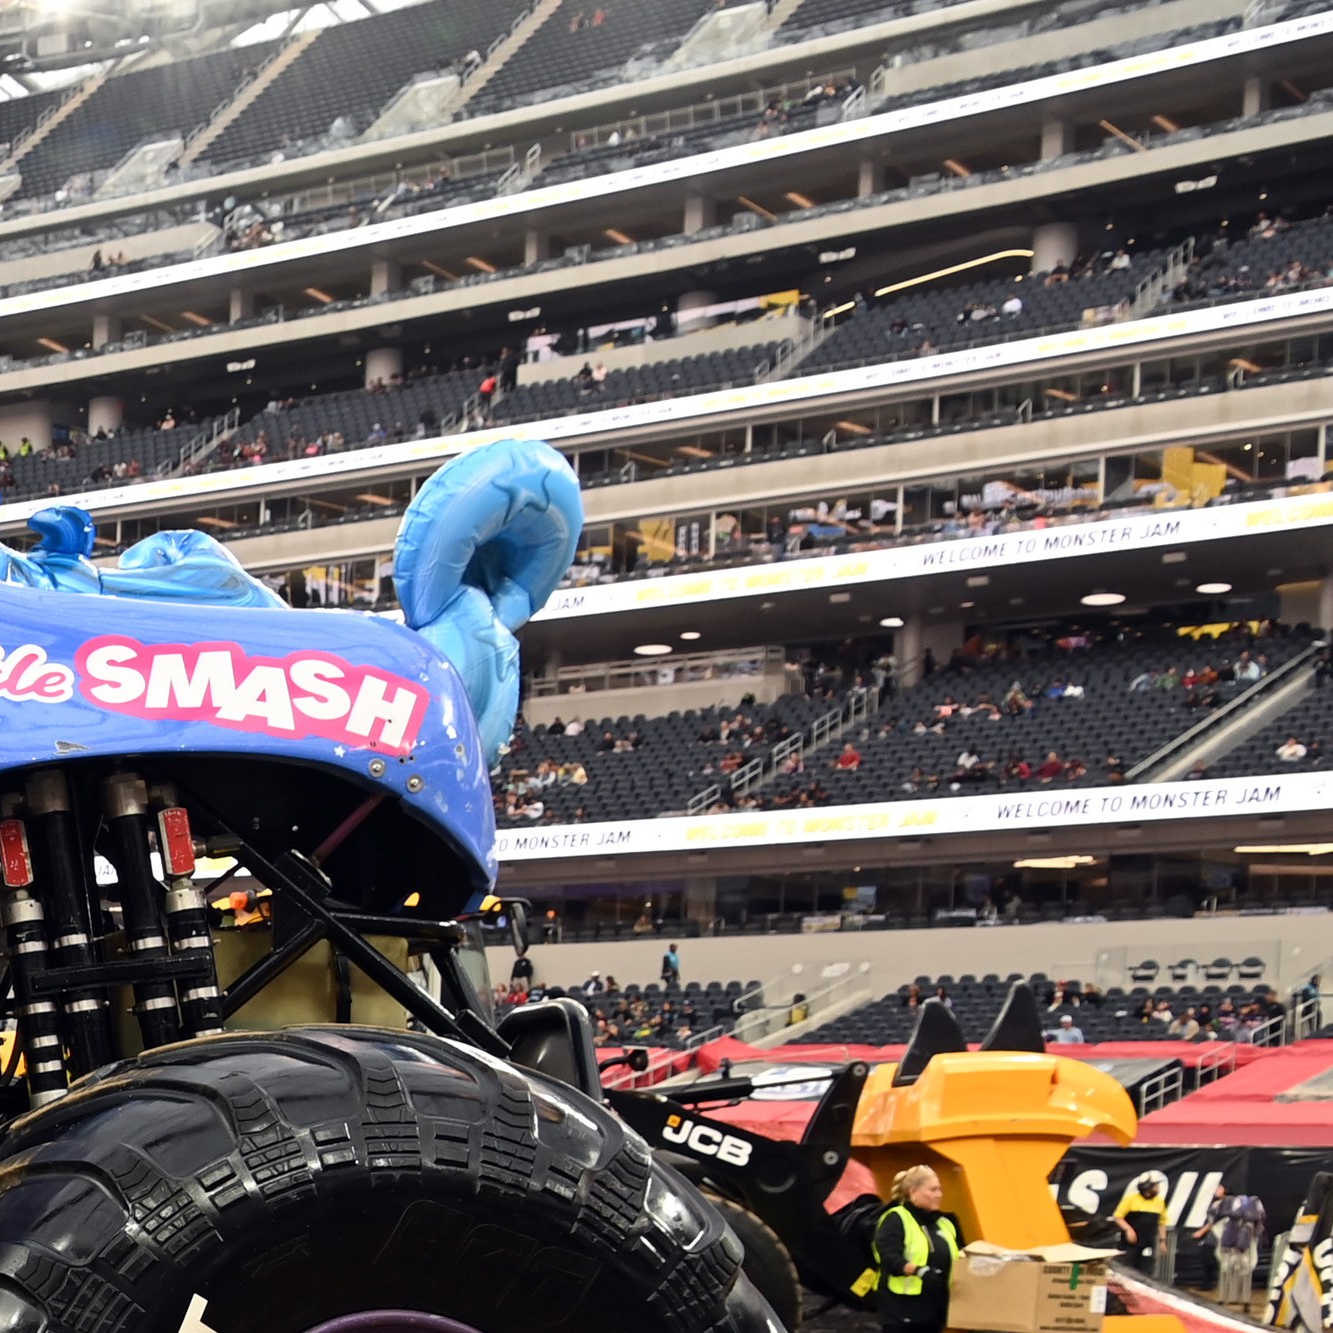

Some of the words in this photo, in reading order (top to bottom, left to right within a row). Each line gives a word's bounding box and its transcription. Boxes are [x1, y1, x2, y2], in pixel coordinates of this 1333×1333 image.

[923, 543, 1007, 566] WELCOME
[1017, 539, 1036, 554] TO
[1044, 527, 1132, 550] MONSTER
[1139, 521, 1180, 539] JAM
[85, 644, 419, 749] SMASH
[998, 798, 1091, 819] WELCOME
[1101, 797, 1122, 813] TO
[1130, 789, 1228, 810] MONSTER
[1236, 786, 1281, 804] JAM
[514, 833, 590, 849] MONSTER
[597, 831, 631, 845] JAM
[662, 1115, 753, 1167] JCB
